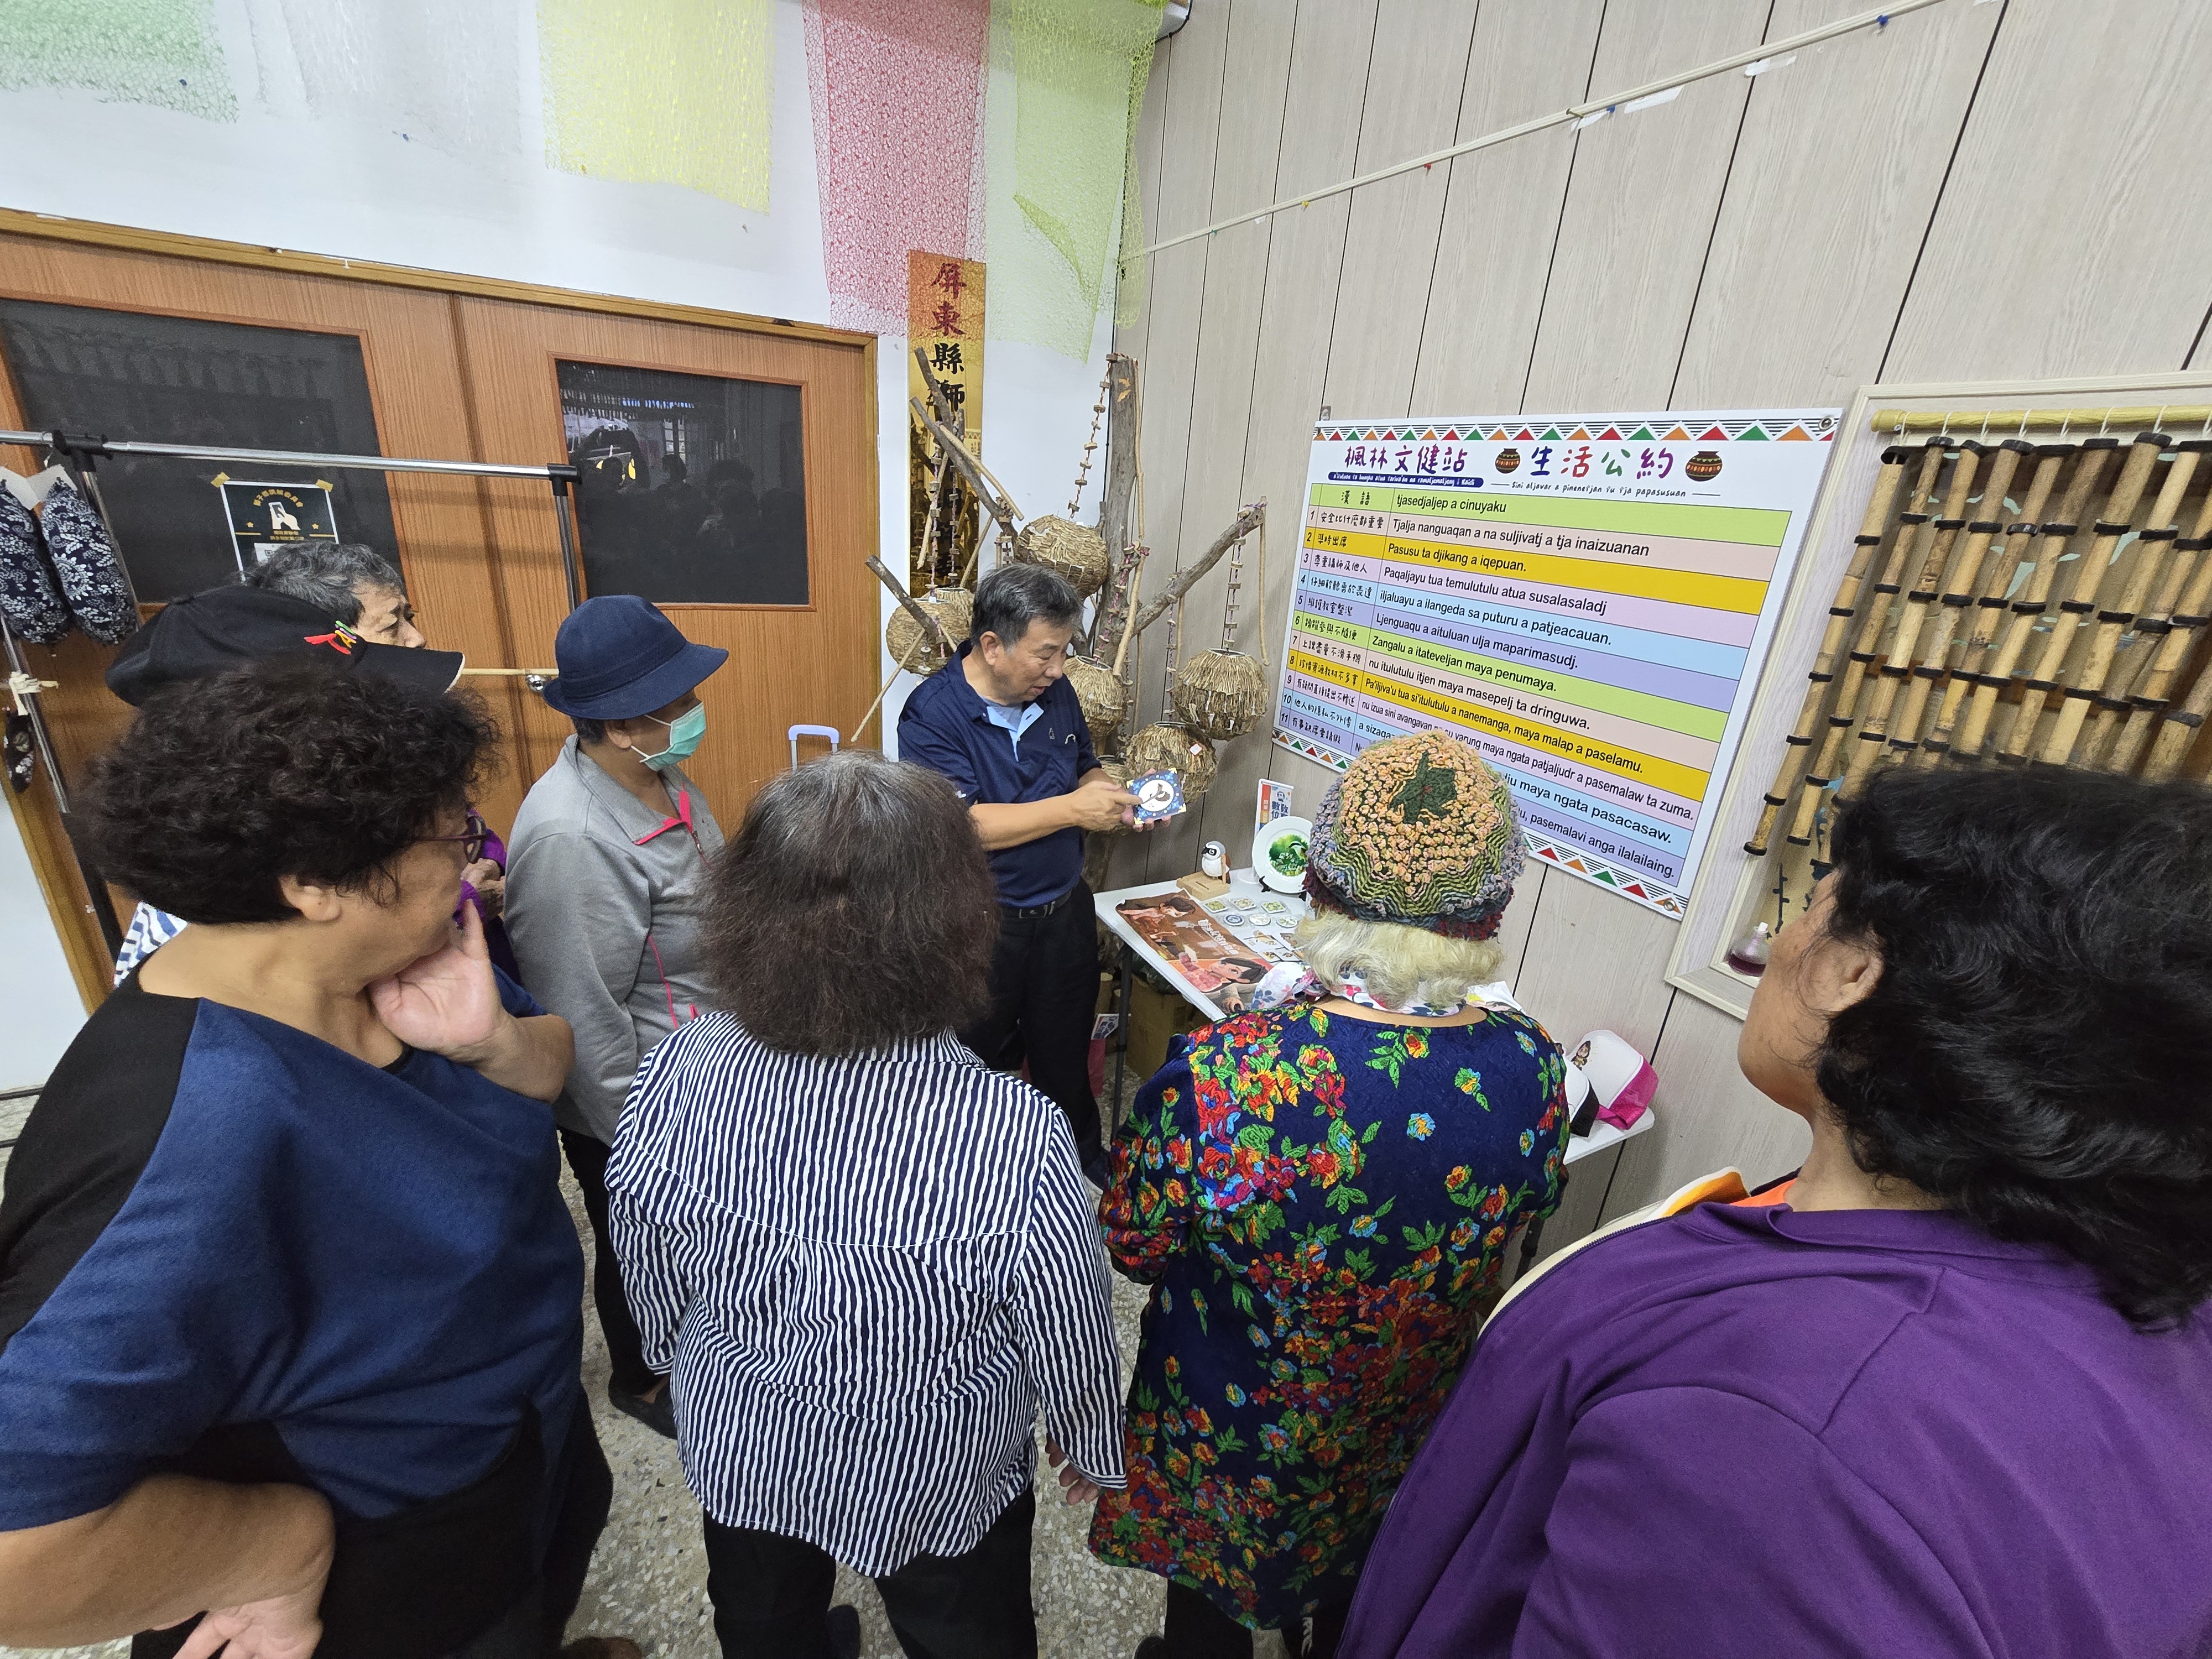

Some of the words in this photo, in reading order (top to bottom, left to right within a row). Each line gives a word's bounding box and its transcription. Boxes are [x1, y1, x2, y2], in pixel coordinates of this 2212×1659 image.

[1344, 443, 1468, 474] 楓林文健站
[1530, 445, 1674, 479] 生活公約
[1526, 482, 1551, 491] aljavar
[1562, 484, 1602, 494] pinenetjan
[1635, 488, 1686, 497] papasusuan
[1396, 494, 1448, 510] tjasedjaljep
[1450, 500, 1457, 509] a
[1459, 498, 1506, 514] cinuyaku
[1310, 510, 1315, 520] 1
[1306, 531, 1312, 542] 2
[1393, 518, 1415, 533] Tjalja
[1417, 524, 1471, 538] nanguaqan
[1473, 529, 1480, 538] a
[1483, 530, 1496, 540] na
[1499, 530, 1543, 547] suljivatj
[1545, 536, 1553, 545] a
[1556, 534, 1572, 550] tja
[1575, 536, 1649, 556] inaizuanan
[1303, 552, 1309, 563] 3
[1387, 542, 1420, 556] Pasusu
[1421, 547, 1431, 558] ta
[1433, 549, 1468, 566] djikang
[1470, 556, 1477, 565] a
[1479, 554, 1526, 571] iqepuan.
[1300, 574, 1306, 584] 4
[1297, 594, 1303, 604] 5
[1384, 566, 1426, 585] Paqaljayu
[1428, 573, 1443, 586] tua
[1445, 576, 1499, 595] temulutulu
[1501, 586, 1526, 600] atua
[1528, 592, 1607, 616] susalasaladj
[1295, 615, 1300, 625] 6
[1380, 589, 1415, 607] iljaluayu
[1416, 599, 1422, 608] a
[1424, 598, 1465, 616] ilangeda
[1467, 609, 1480, 619] sa
[1481, 612, 1518, 626] puturu
[1520, 619, 1528, 628] a
[1530, 621, 1611, 645] patjeacauan.
[1292, 635, 1297, 644] 7
[1376, 612, 1421, 633] Ljenguaqu
[1422, 625, 1428, 634] a
[1430, 625, 1469, 643] aituluan
[1472, 635, 1490, 649] ulja
[1492, 641, 1578, 670] maparimasudj.
[1289, 655, 1295, 665] 8
[1371, 635, 1406, 653] Zangalu
[1415, 645, 1463, 667] itateveljan
[1464, 661, 1493, 676] maya
[1494, 669, 1556, 692] penumaya.
[1287, 675, 1292, 684] 9
[1283, 693, 1291, 704] 10
[1369, 659, 1379, 669] nu
[1380, 660, 1414, 679] itulutulu
[1416, 670, 1436, 685] itjen
[1437, 679, 1463, 693] maya
[1465, 687, 1514, 710] masepelj
[1516, 698, 1527, 712] ta
[1530, 703, 1589, 729] dringuwa.
[1281, 712, 1288, 723] 11
[1365, 677, 1396, 696] Pa'iljiva'u
[1397, 687, 1409, 700] tua
[1410, 692, 1449, 712] si'itulutulu
[1451, 706, 1457, 715] a
[1458, 709, 1511, 734] nanemanga,
[1514, 726, 1540, 741] maya
[1541, 734, 1573, 753] malap
[1575, 745, 1583, 754] a
[1584, 748, 1642, 773] paselamu.
[1361, 701, 1370, 709] nu
[1370, 701, 1384, 714] izua
[1384, 707, 1396, 718] sini
[1396, 713, 1433, 731] avangavan
[1454, 732, 1481, 751] varung
[1482, 742, 1504, 757] maya
[1505, 750, 1530, 764] ngata
[1530, 758, 1575, 779] patjaljudr
[1576, 773, 1583, 783] a
[1584, 776, 1644, 802] pasemalaw
[1646, 794, 1657, 808] ta
[1658, 801, 1693, 820] zuma.
[1519, 781, 1550, 799] maya
[1553, 793, 1588, 813] ngata
[1590, 807, 1671, 843] pasacasaw.
[1530, 813, 1587, 842] pasemalavi
[1588, 837, 1615, 854] anga
[1618, 845, 1674, 878] ilalailaing.
